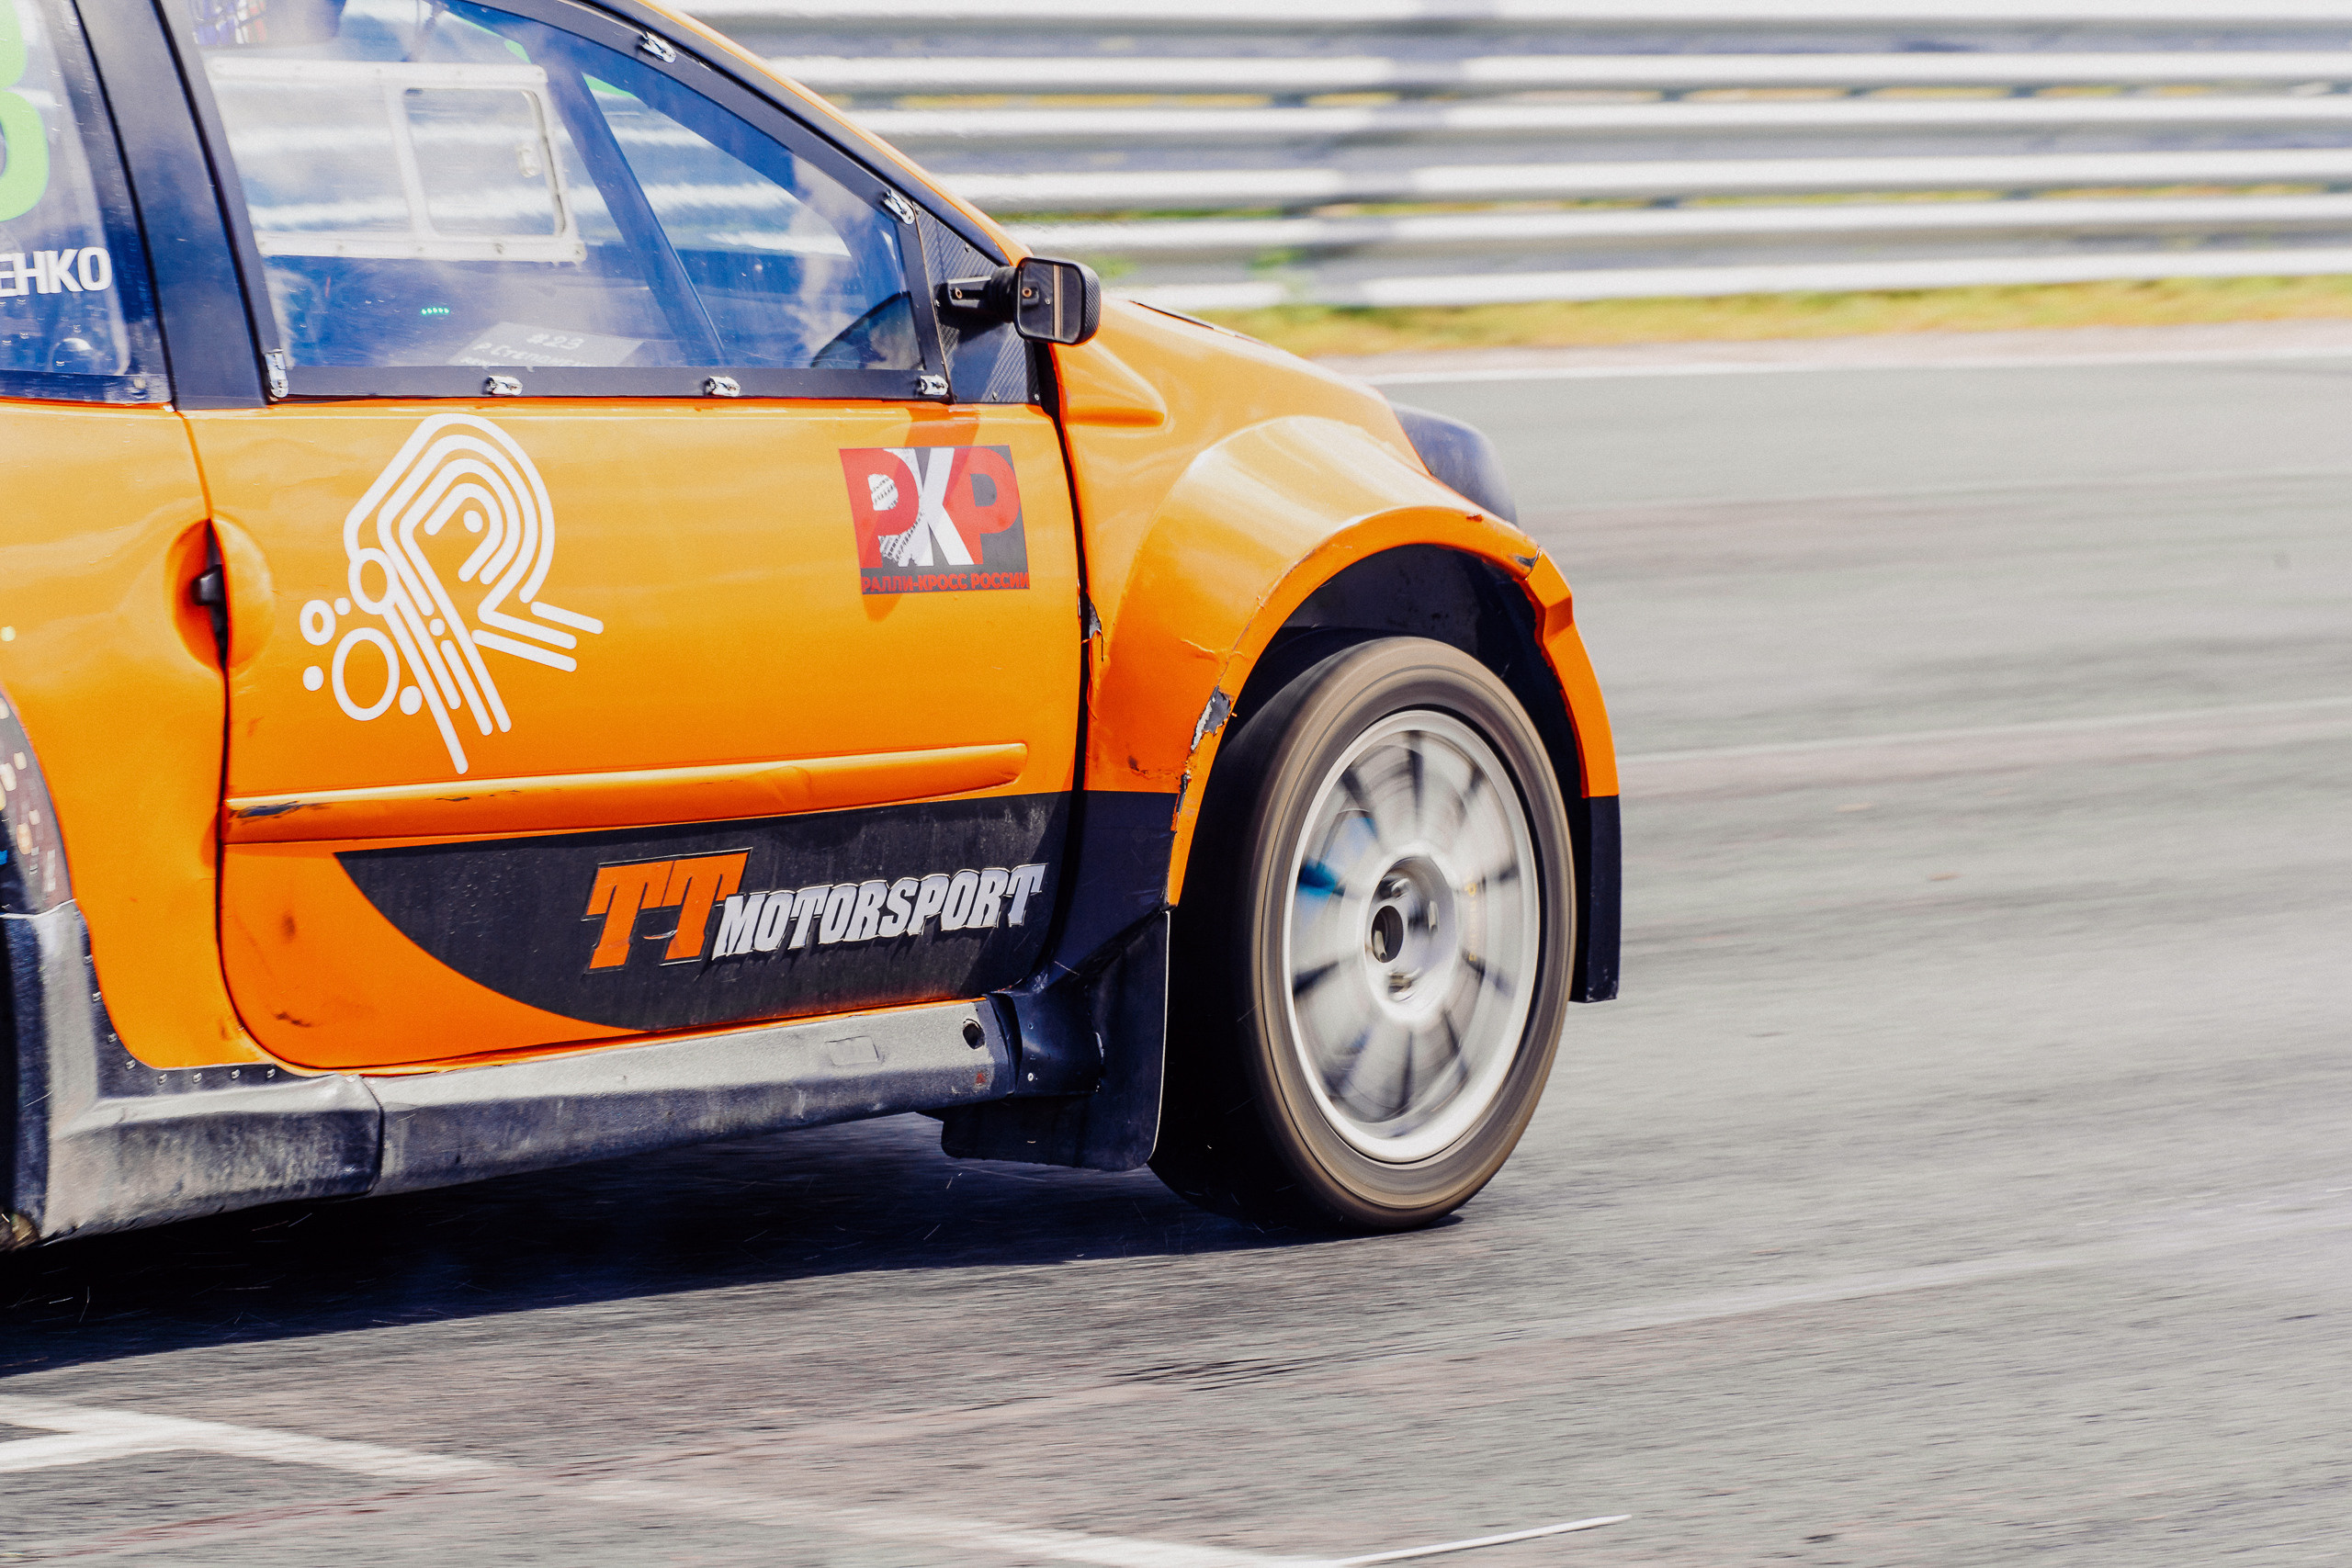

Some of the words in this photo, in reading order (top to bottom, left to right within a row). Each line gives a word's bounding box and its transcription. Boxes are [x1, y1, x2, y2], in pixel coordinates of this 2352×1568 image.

[862, 574, 967, 592] РАЛЛИ-КРОСС
[971, 572, 1029, 589] РОССИИ
[711, 863, 1046, 959] MOTORSPORT
